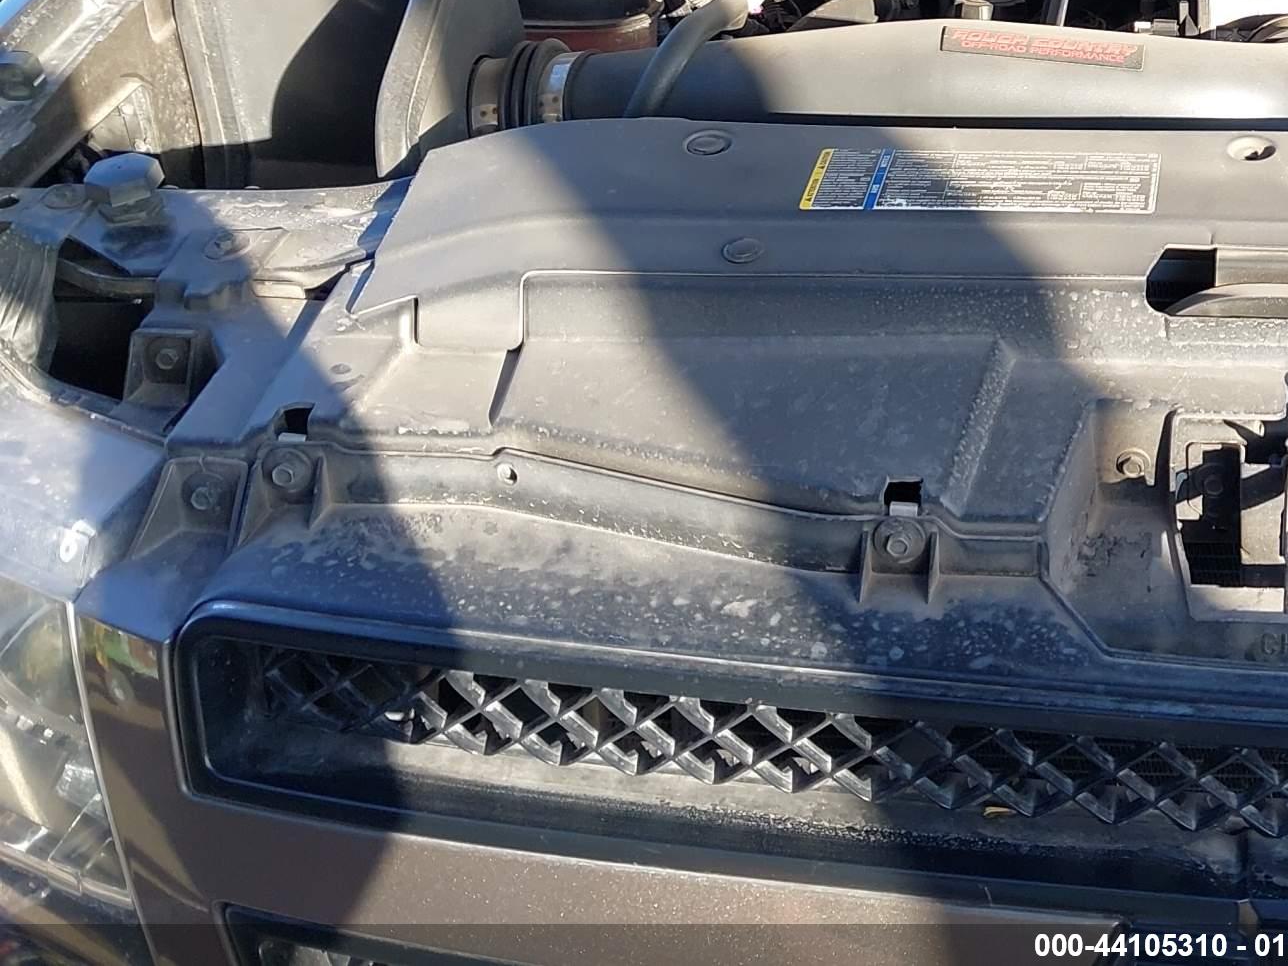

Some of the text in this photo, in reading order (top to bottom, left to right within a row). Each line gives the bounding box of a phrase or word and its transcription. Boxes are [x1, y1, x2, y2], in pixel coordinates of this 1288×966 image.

[952, 29, 1137, 56] ROUGH COUNTRY
[1029, 46, 1126, 64] PERFORMANCE
